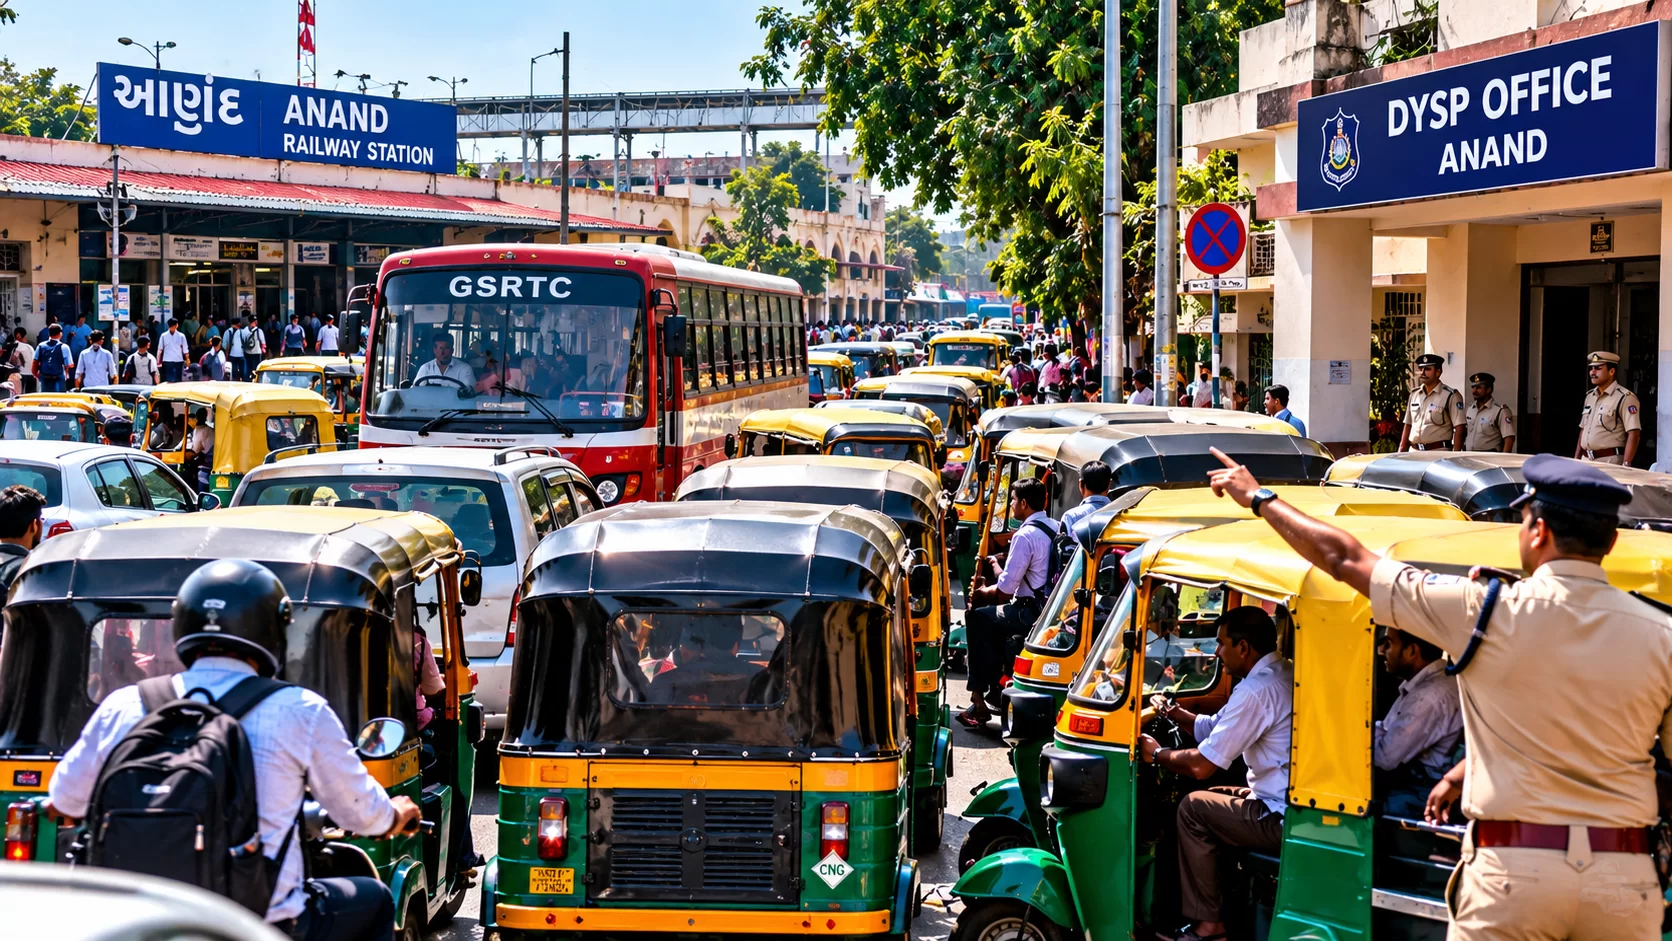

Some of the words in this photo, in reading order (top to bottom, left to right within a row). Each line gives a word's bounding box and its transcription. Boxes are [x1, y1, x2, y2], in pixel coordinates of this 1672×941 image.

[283, 94, 389, 134] ANAND
[1389, 86, 1470, 138] DYSP
[1482, 55, 1612, 120] OFFICE
[283, 133, 361, 160] RAILWAY
[367, 141, 434, 166] STATION
[1438, 128, 1548, 175] ANAND
[449, 275, 573, 299] GSRTC
[819, 863, 845, 876] CNG
